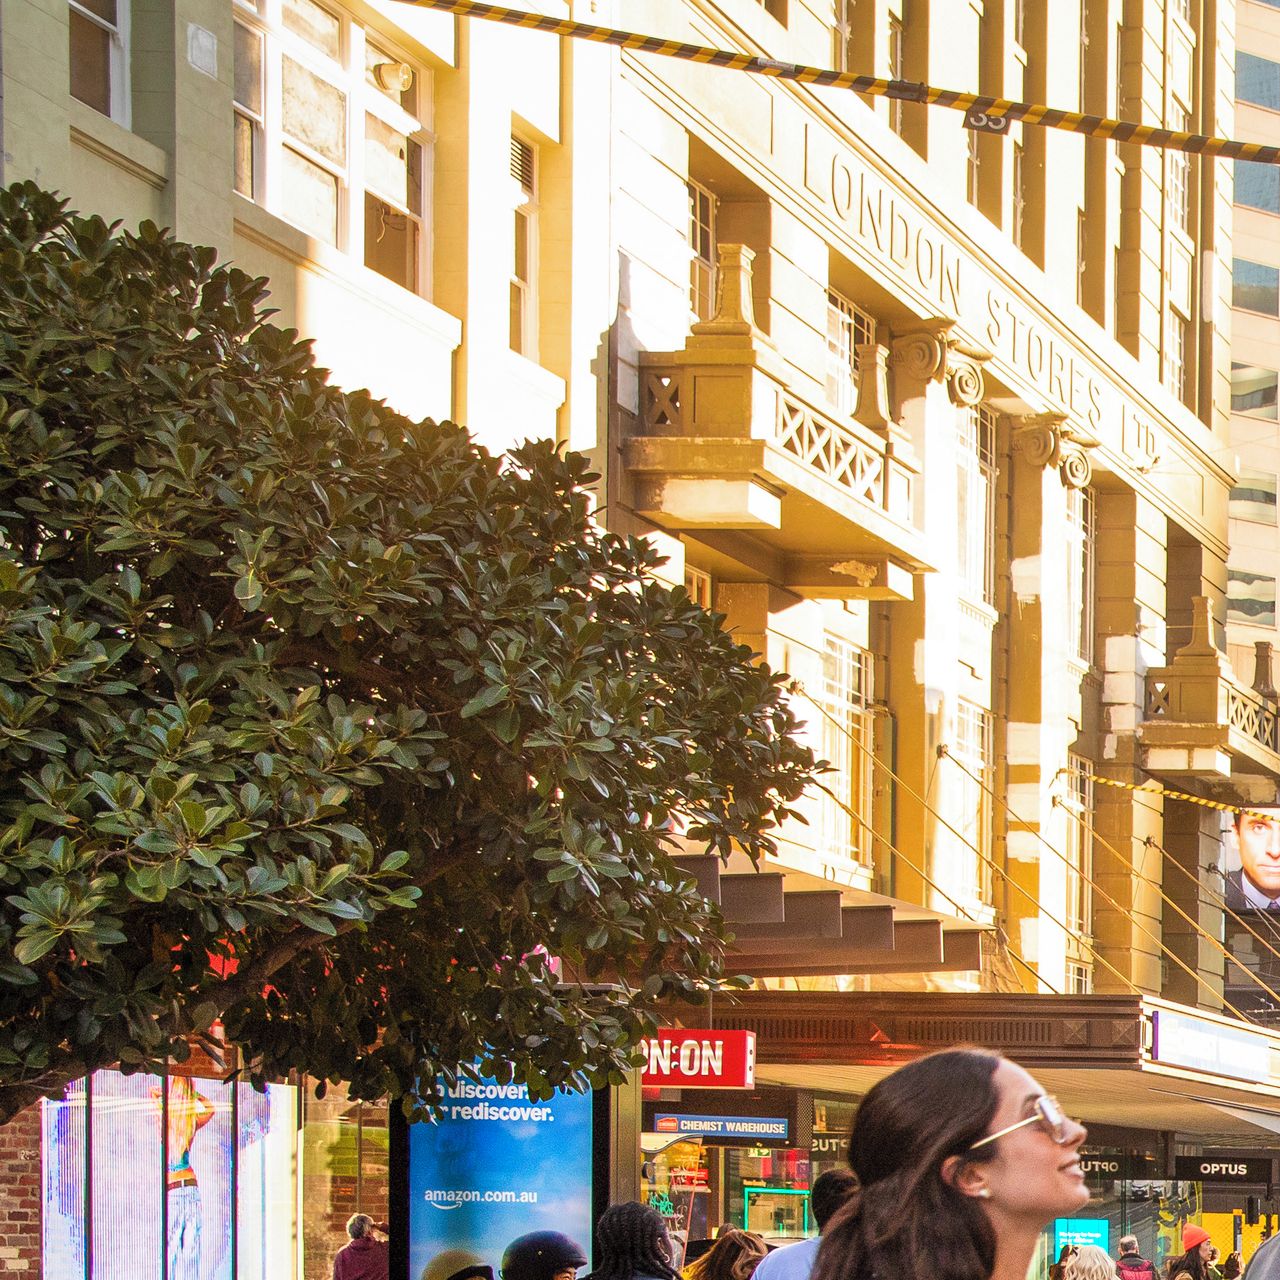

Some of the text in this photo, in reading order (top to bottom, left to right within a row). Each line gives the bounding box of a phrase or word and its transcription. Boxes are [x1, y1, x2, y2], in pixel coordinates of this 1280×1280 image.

[804, 122, 961, 318] LONDON
[987, 289, 1101, 430] STORES
[452, 1102, 555, 1122] rediscover.
[680, 1120, 723, 1131] CHEMIST
[726, 1121, 786, 1134] WAREHOUSE
[1200, 1163, 1248, 1175] OPTUS
[424, 1189, 538, 1204] amazon.com.au
